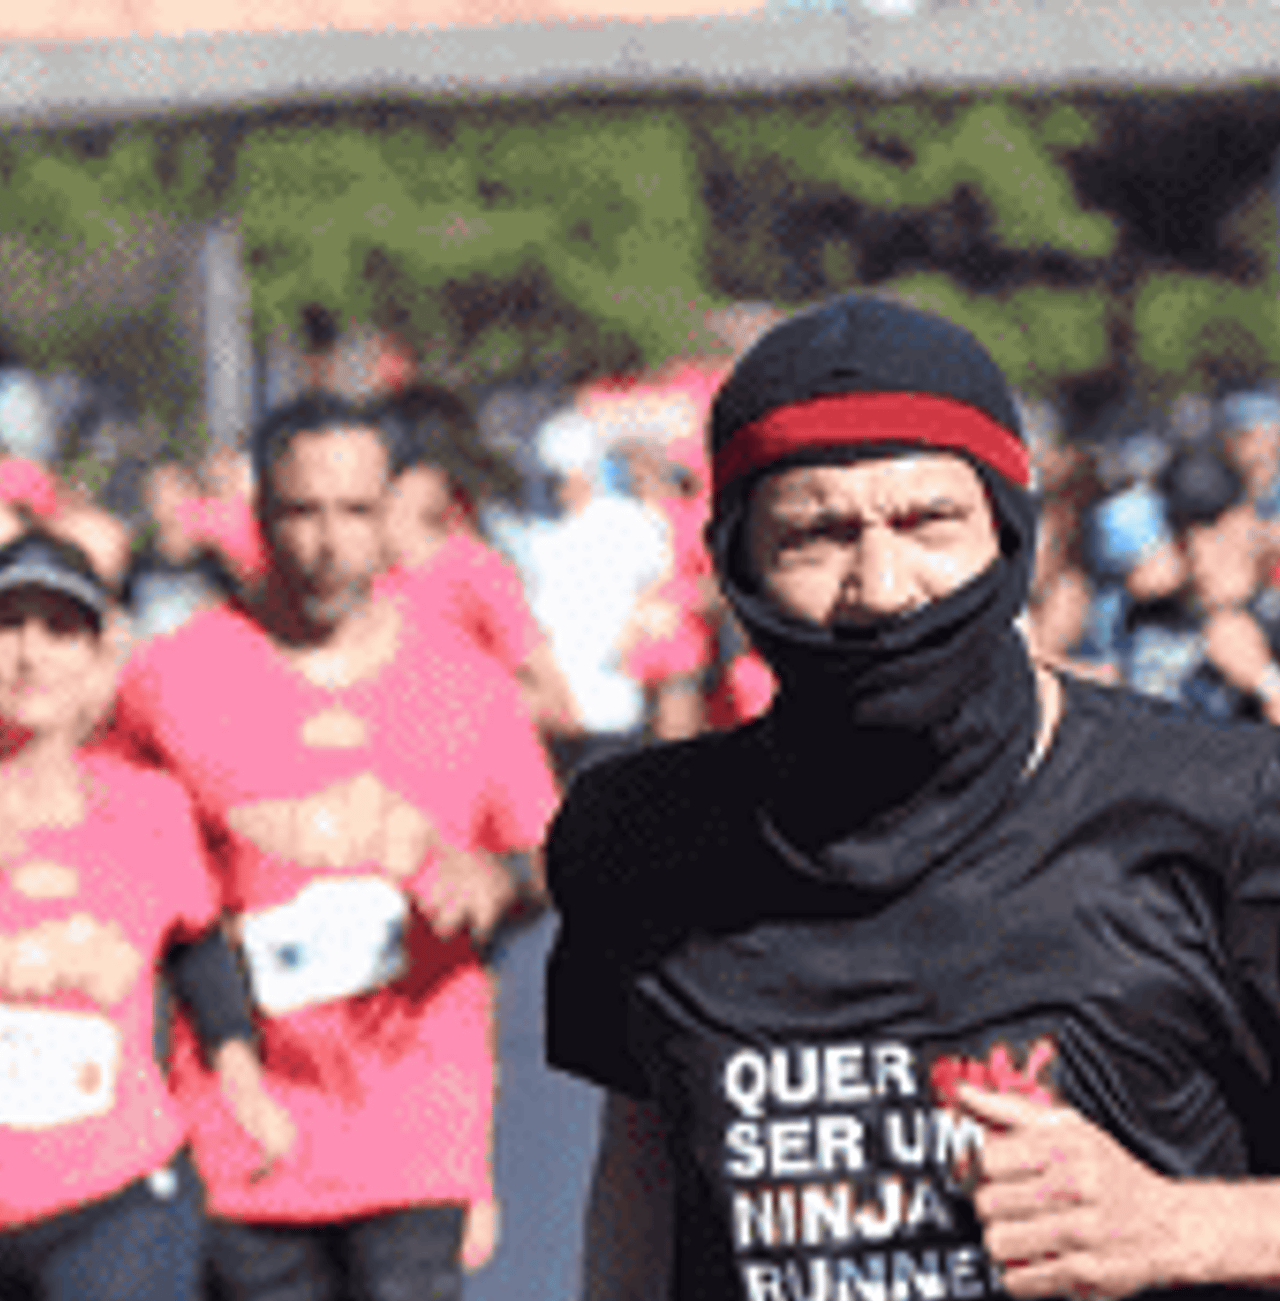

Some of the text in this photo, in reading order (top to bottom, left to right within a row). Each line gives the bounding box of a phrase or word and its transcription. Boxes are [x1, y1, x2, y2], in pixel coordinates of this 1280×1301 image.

[725, 1045, 917, 1117] QUER
[726, 1114, 865, 1177] SER
[733, 1175, 953, 1248] NINJA
